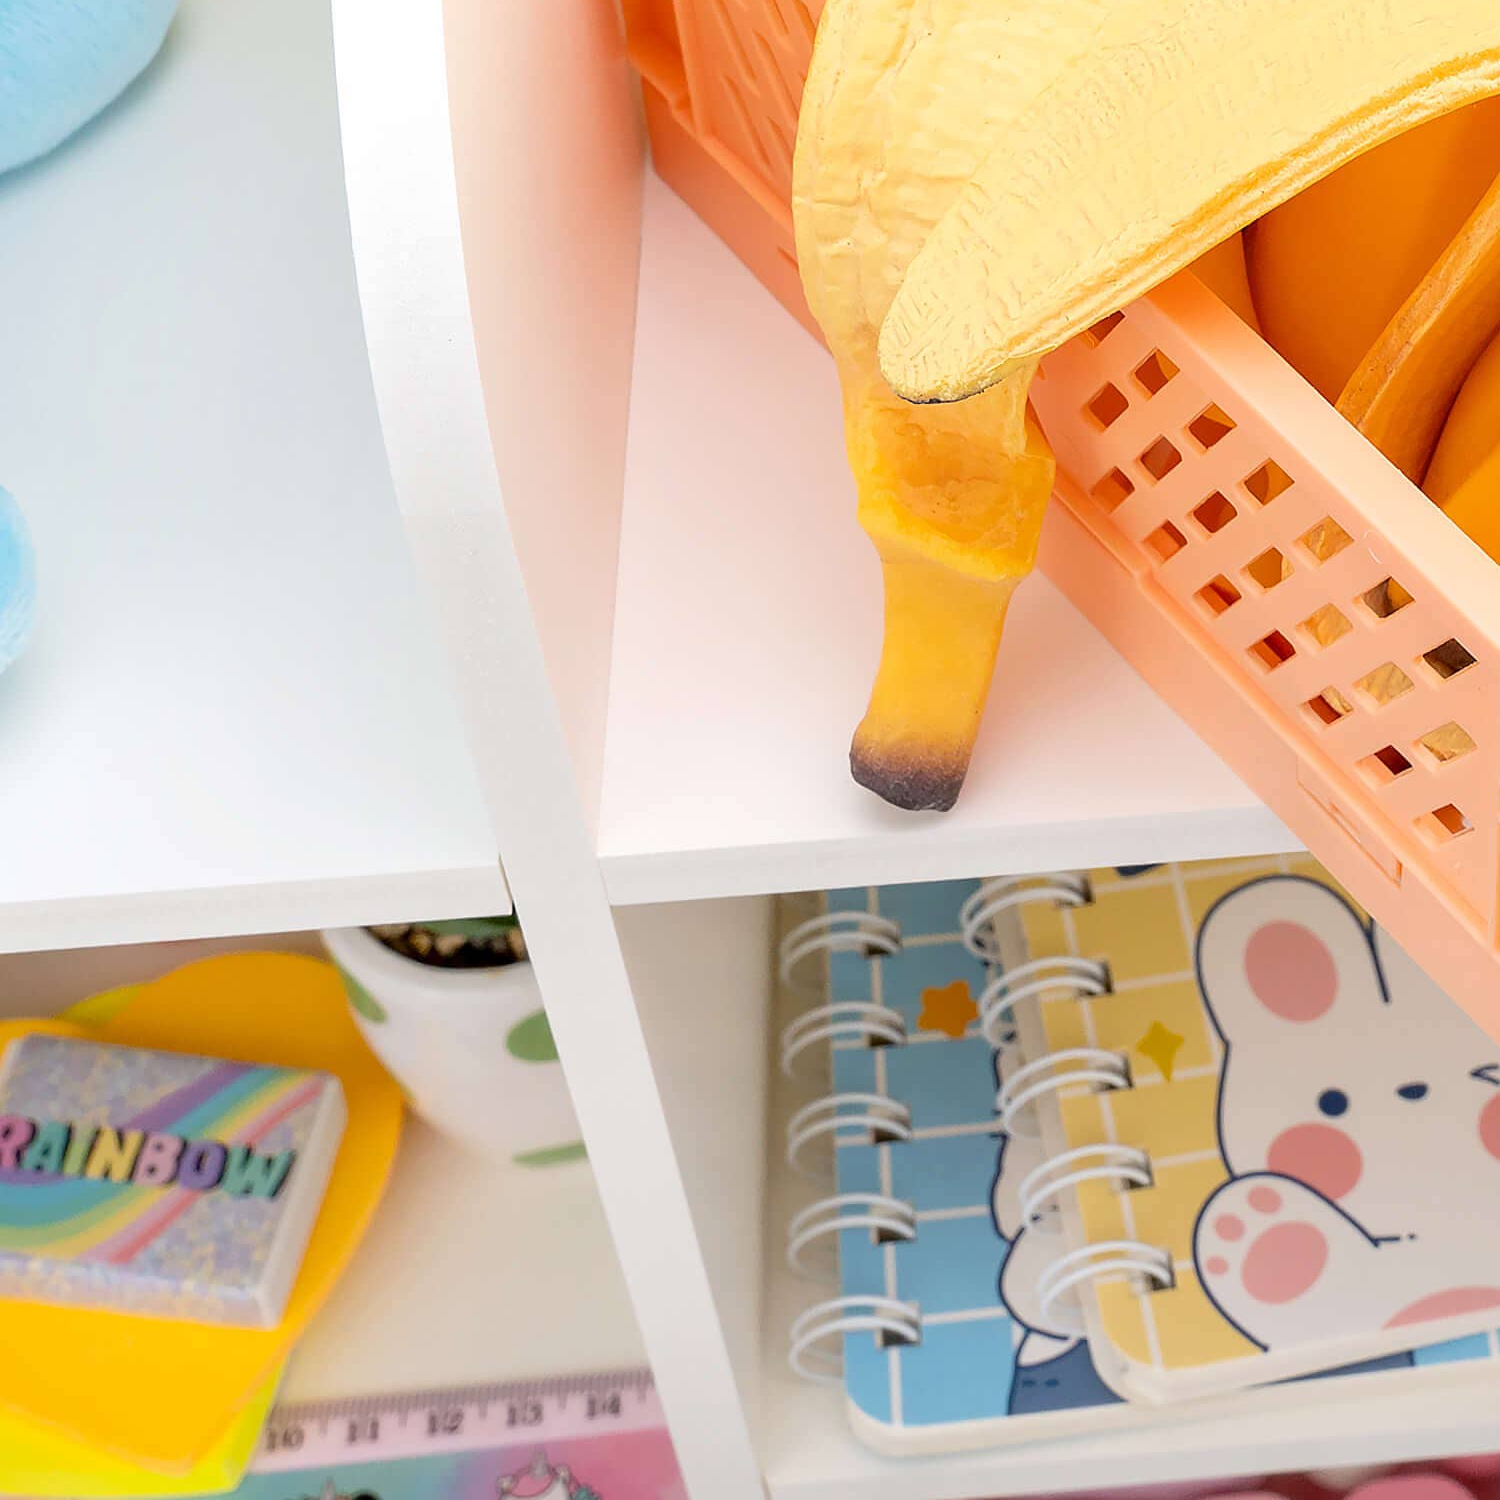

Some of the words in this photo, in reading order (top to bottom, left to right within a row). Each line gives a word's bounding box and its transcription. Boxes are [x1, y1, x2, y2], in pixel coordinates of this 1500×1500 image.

[0, 1115, 296, 1199] RAINBOW
[266, 1427, 304, 1451] 10
[346, 1419, 379, 1443] 11
[426, 1409, 464, 1435] 12
[506, 1404, 544, 1426] 13
[586, 1395, 622, 1419] 14
